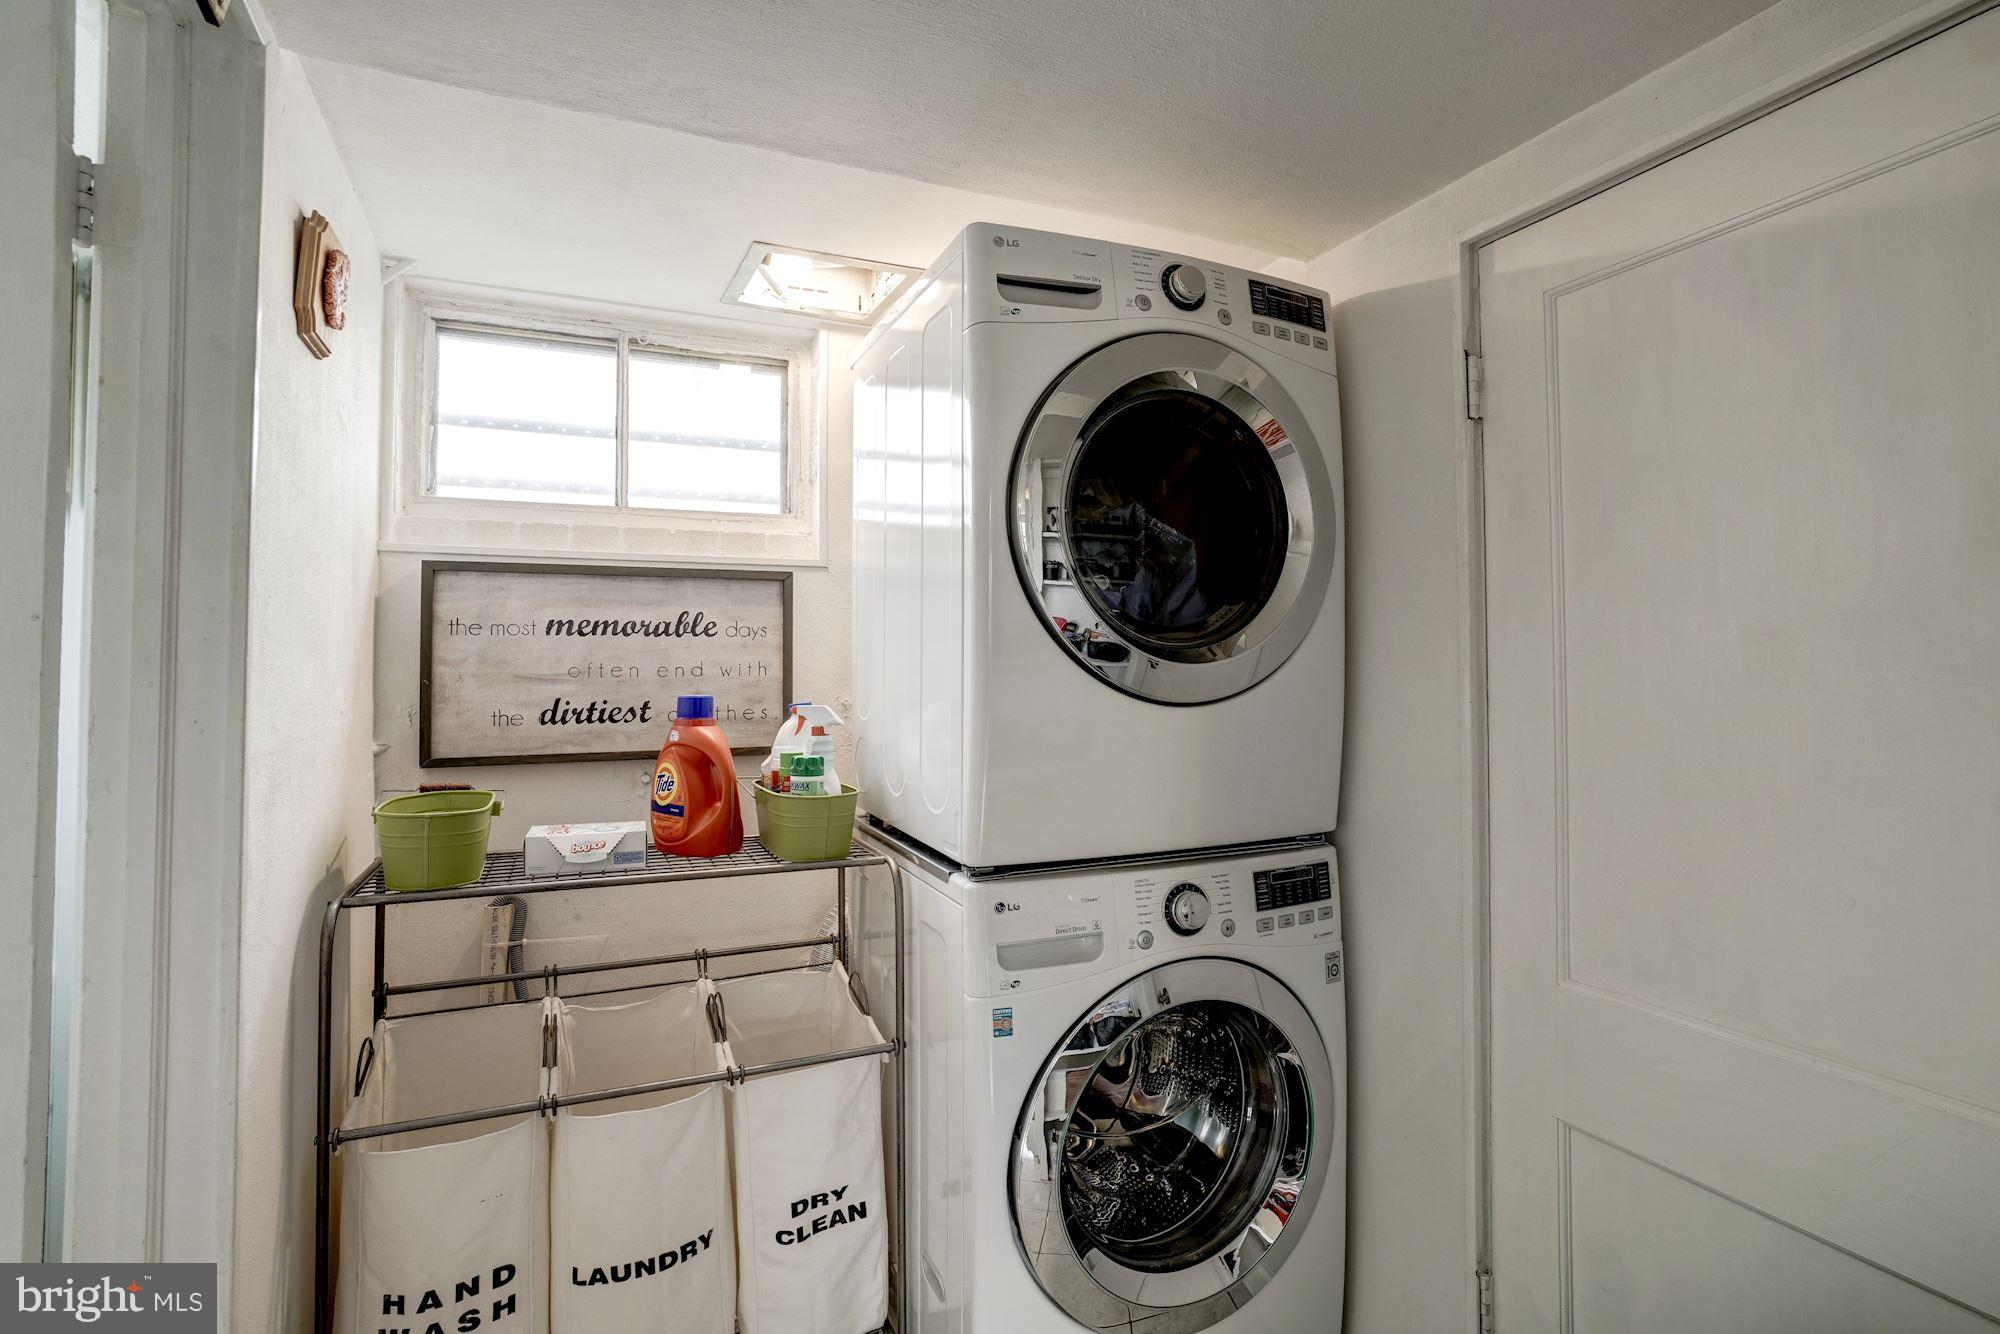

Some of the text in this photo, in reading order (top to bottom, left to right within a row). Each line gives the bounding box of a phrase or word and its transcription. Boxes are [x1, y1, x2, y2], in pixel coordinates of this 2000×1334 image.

[1006, 238, 1020, 248] LG
[449, 611, 767, 641] the most memorable days
[567, 661, 768, 679] often end with
[491, 697, 768, 727] the dirtiest cthes
[655, 773, 675, 795] Tide
[571, 840, 606, 853] bounce
[1007, 902, 1021, 912] LG
[1055, 925, 1087, 935] Direct Drive
[790, 1184, 849, 1219] DRY
[775, 1201, 867, 1246] CLEAN
[572, 1228, 714, 1287] LAUNDRY
[382, 1263, 516, 1315] HAND
[378, 1293, 516, 1334] ASH
